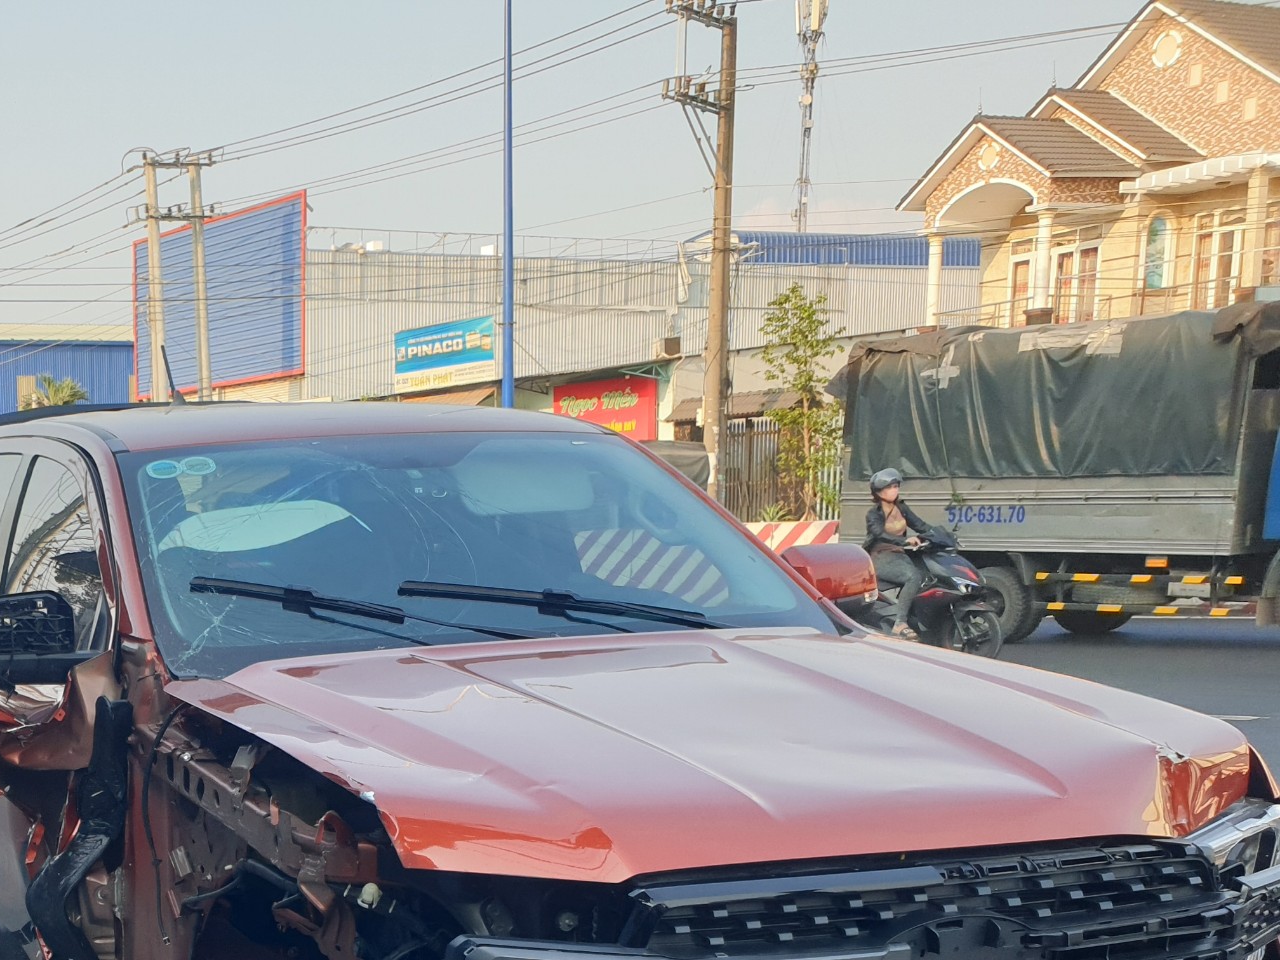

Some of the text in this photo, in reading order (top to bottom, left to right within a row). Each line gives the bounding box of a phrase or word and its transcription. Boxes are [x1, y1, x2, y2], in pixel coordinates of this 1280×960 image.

[407, 338, 463, 359] PINACO
[560, 387, 639, 417] Ngọc Mến
[948, 505, 1026, 524] 51C-631.70
